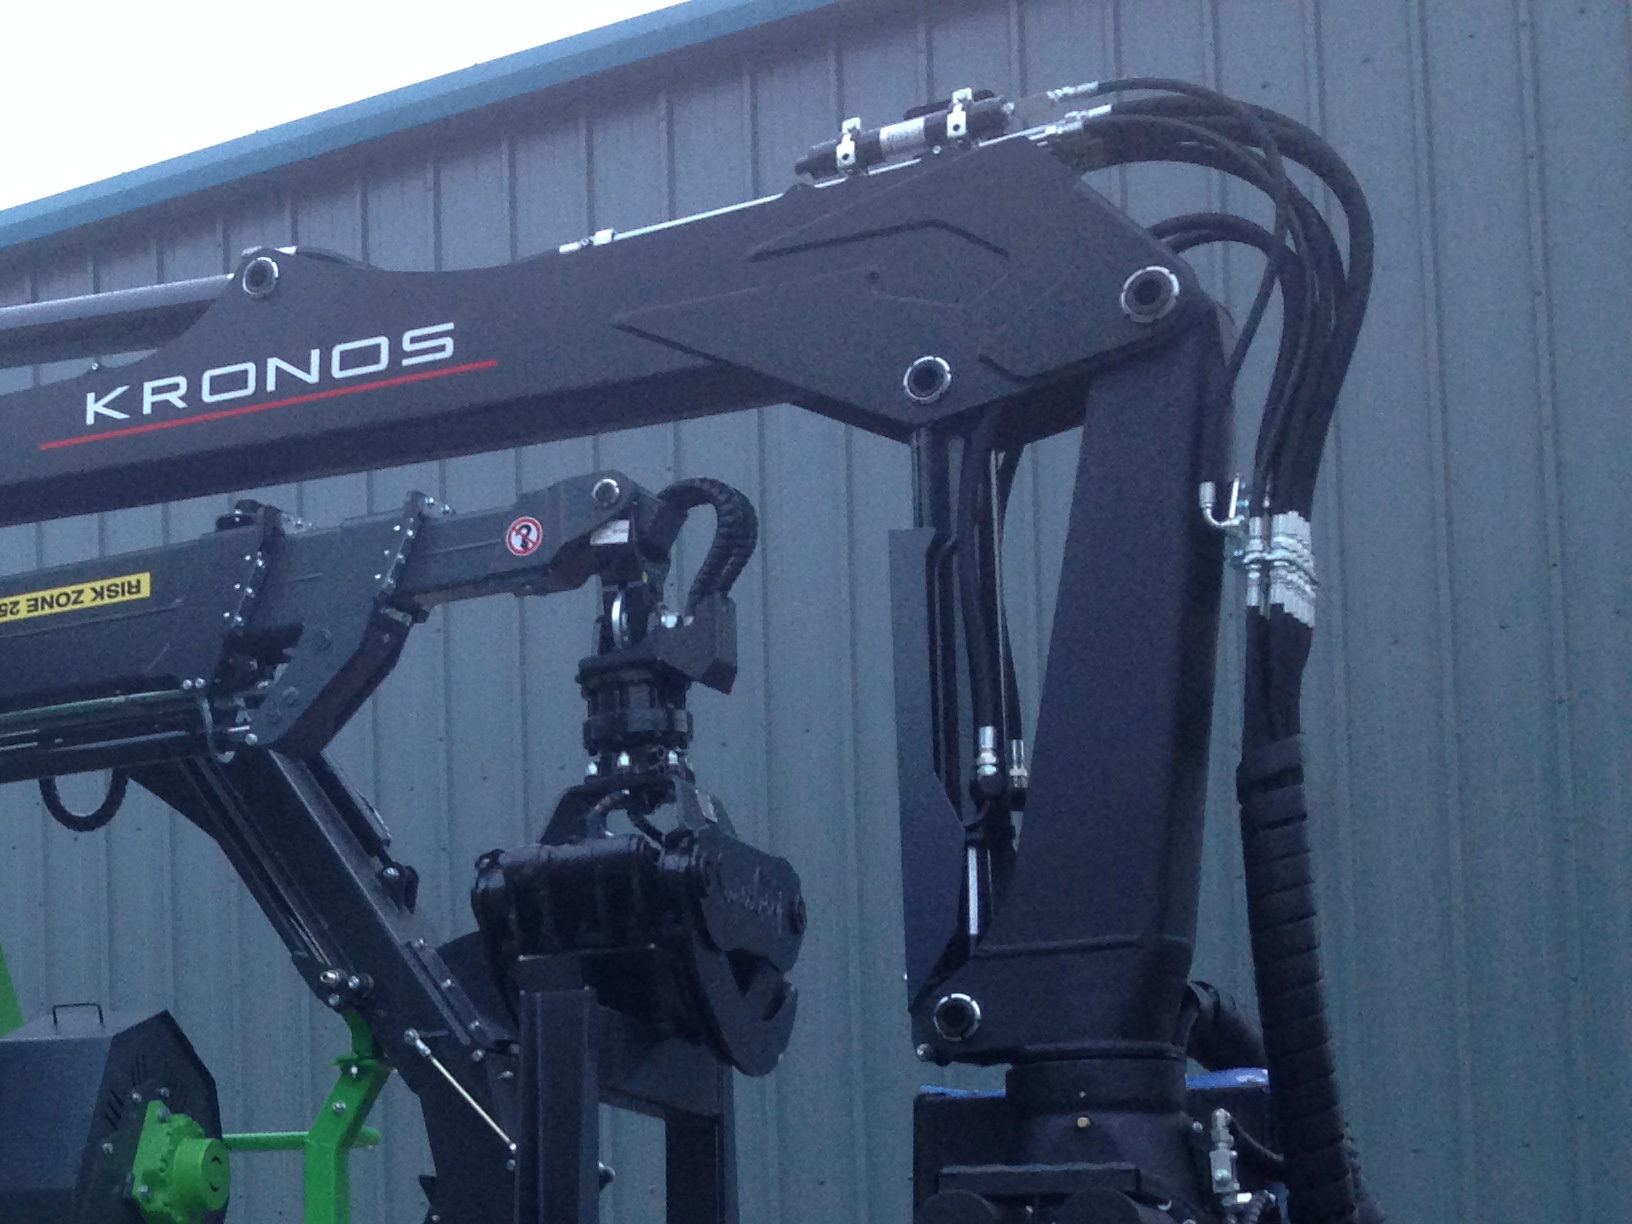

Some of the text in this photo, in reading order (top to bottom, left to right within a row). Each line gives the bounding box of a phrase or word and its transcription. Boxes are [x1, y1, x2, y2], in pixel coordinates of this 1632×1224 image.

[84, 321, 456, 425] KRONOS
[26, 588, 85, 614] ZONE
[90, 578, 142, 603] RISK
